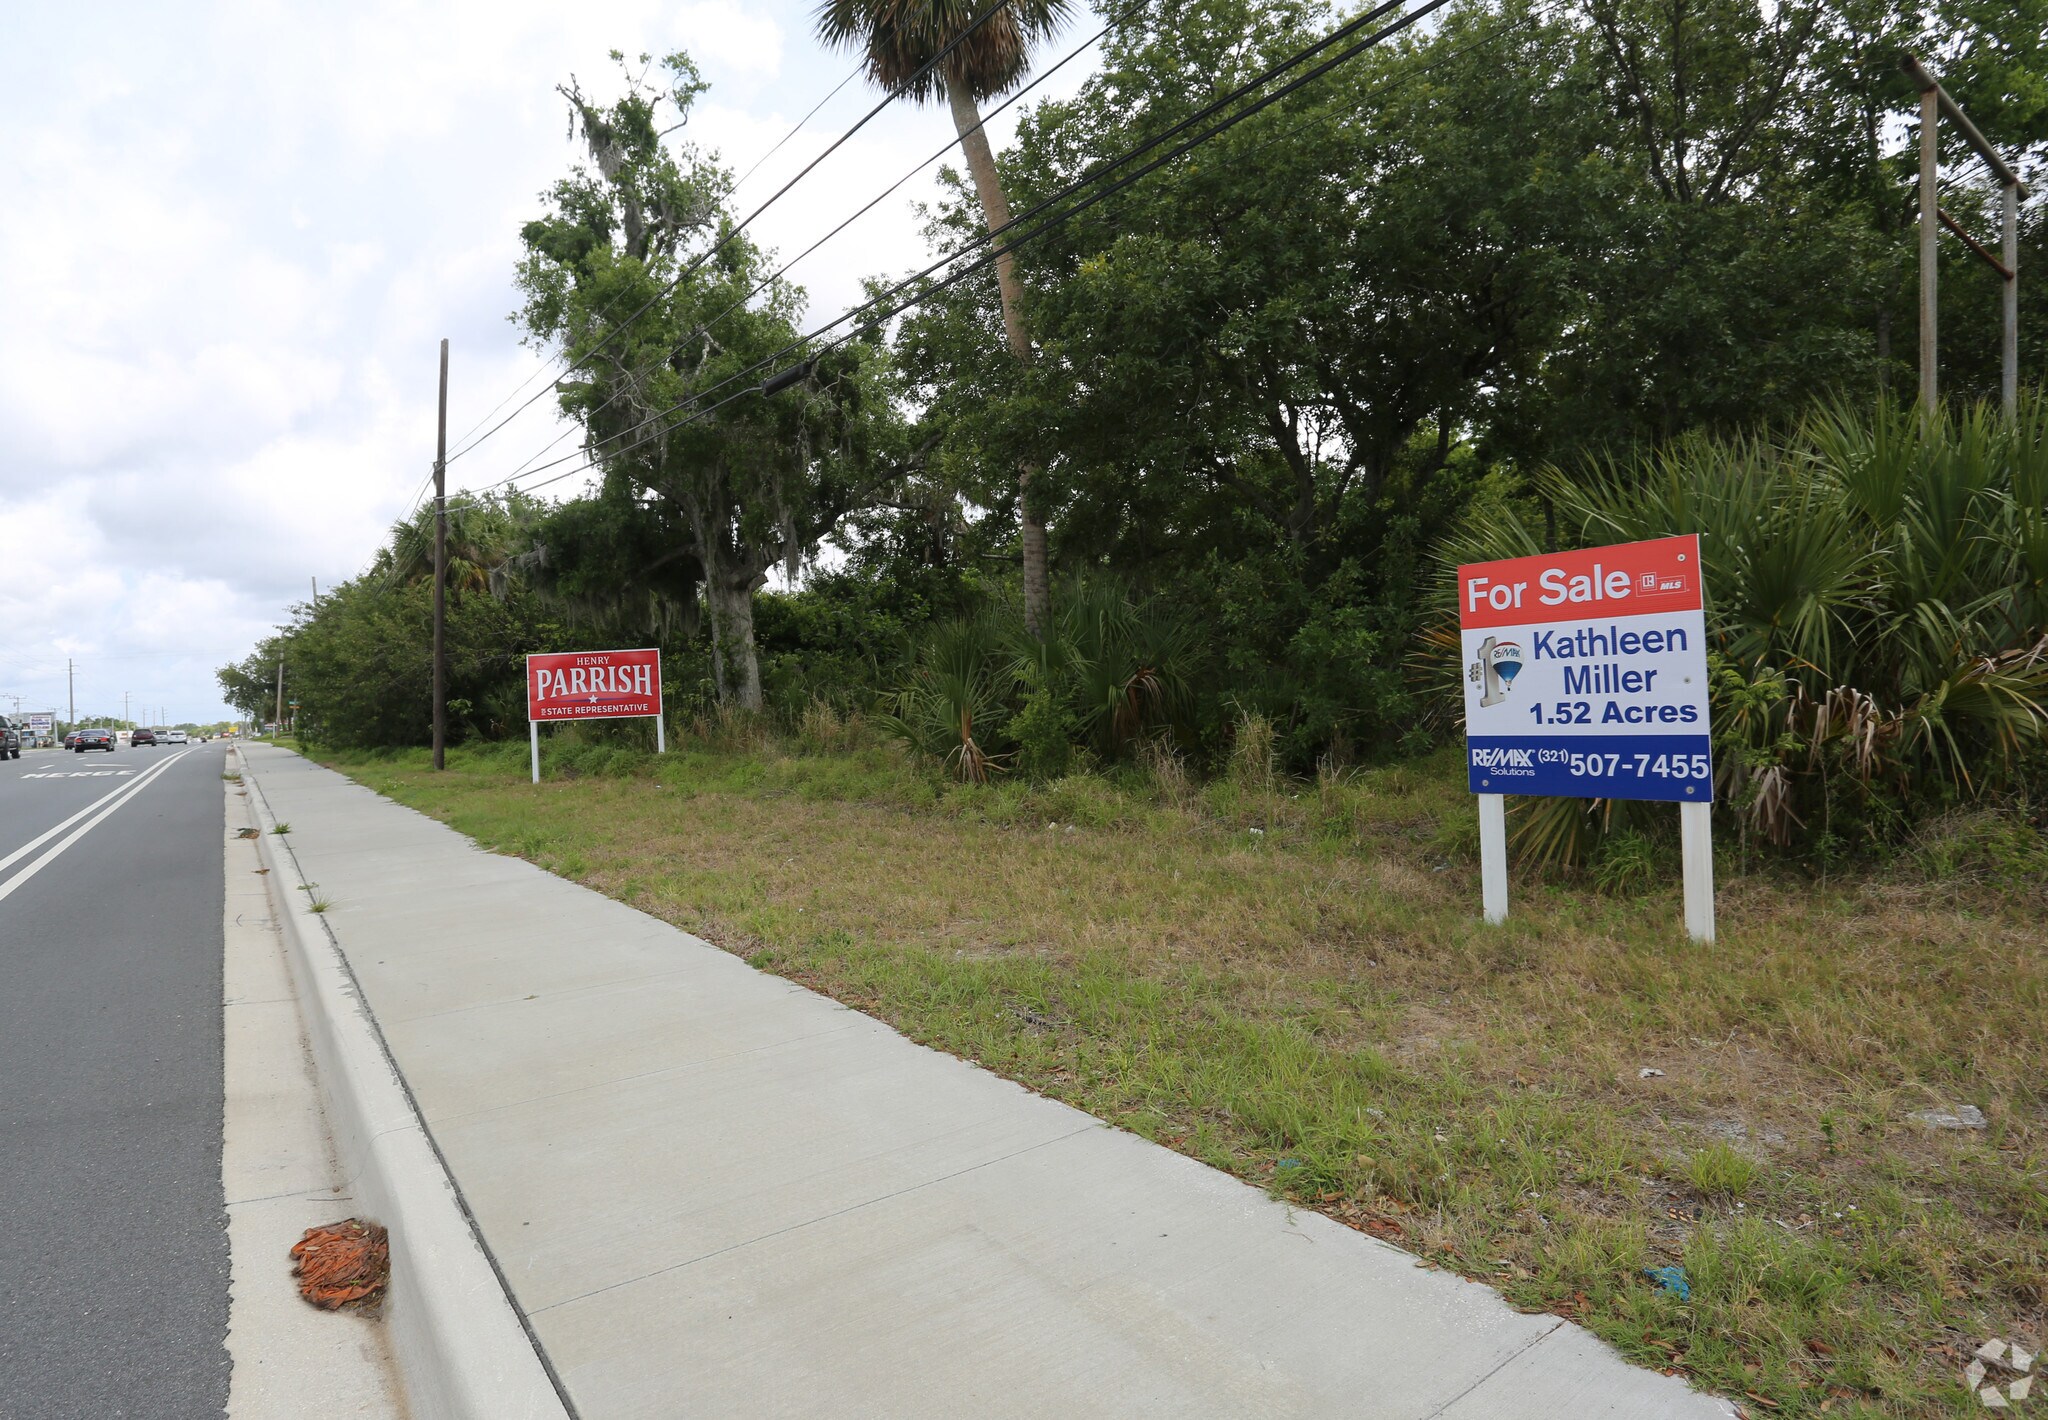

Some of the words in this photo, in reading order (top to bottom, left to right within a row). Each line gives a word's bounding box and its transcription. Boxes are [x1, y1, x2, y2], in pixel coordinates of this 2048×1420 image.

[1468, 577, 1527, 612] For
[1539, 564, 1631, 606] Sale
[1660, 581, 1682, 590] MLS
[1533, 626, 1687, 660] Kathleen
[577, 656, 609, 665] HENRY
[537, 665, 652, 701] PARRISH
[1563, 664, 1658, 695] Miller
[547, 707, 573, 716] STATE
[575, 704, 648, 714] REPRESENTATIVE
[1530, 702, 1592, 725] 1.52
[1601, 701, 1698, 724] Acres
[20, 770, 137, 779] MERGE
[1472, 748, 1534, 767] RE/MAX
[1538, 748, 1569, 764] (321)
[1570, 754, 1709, 778] 507-7455
[1490, 767, 1536, 777] Solutions
